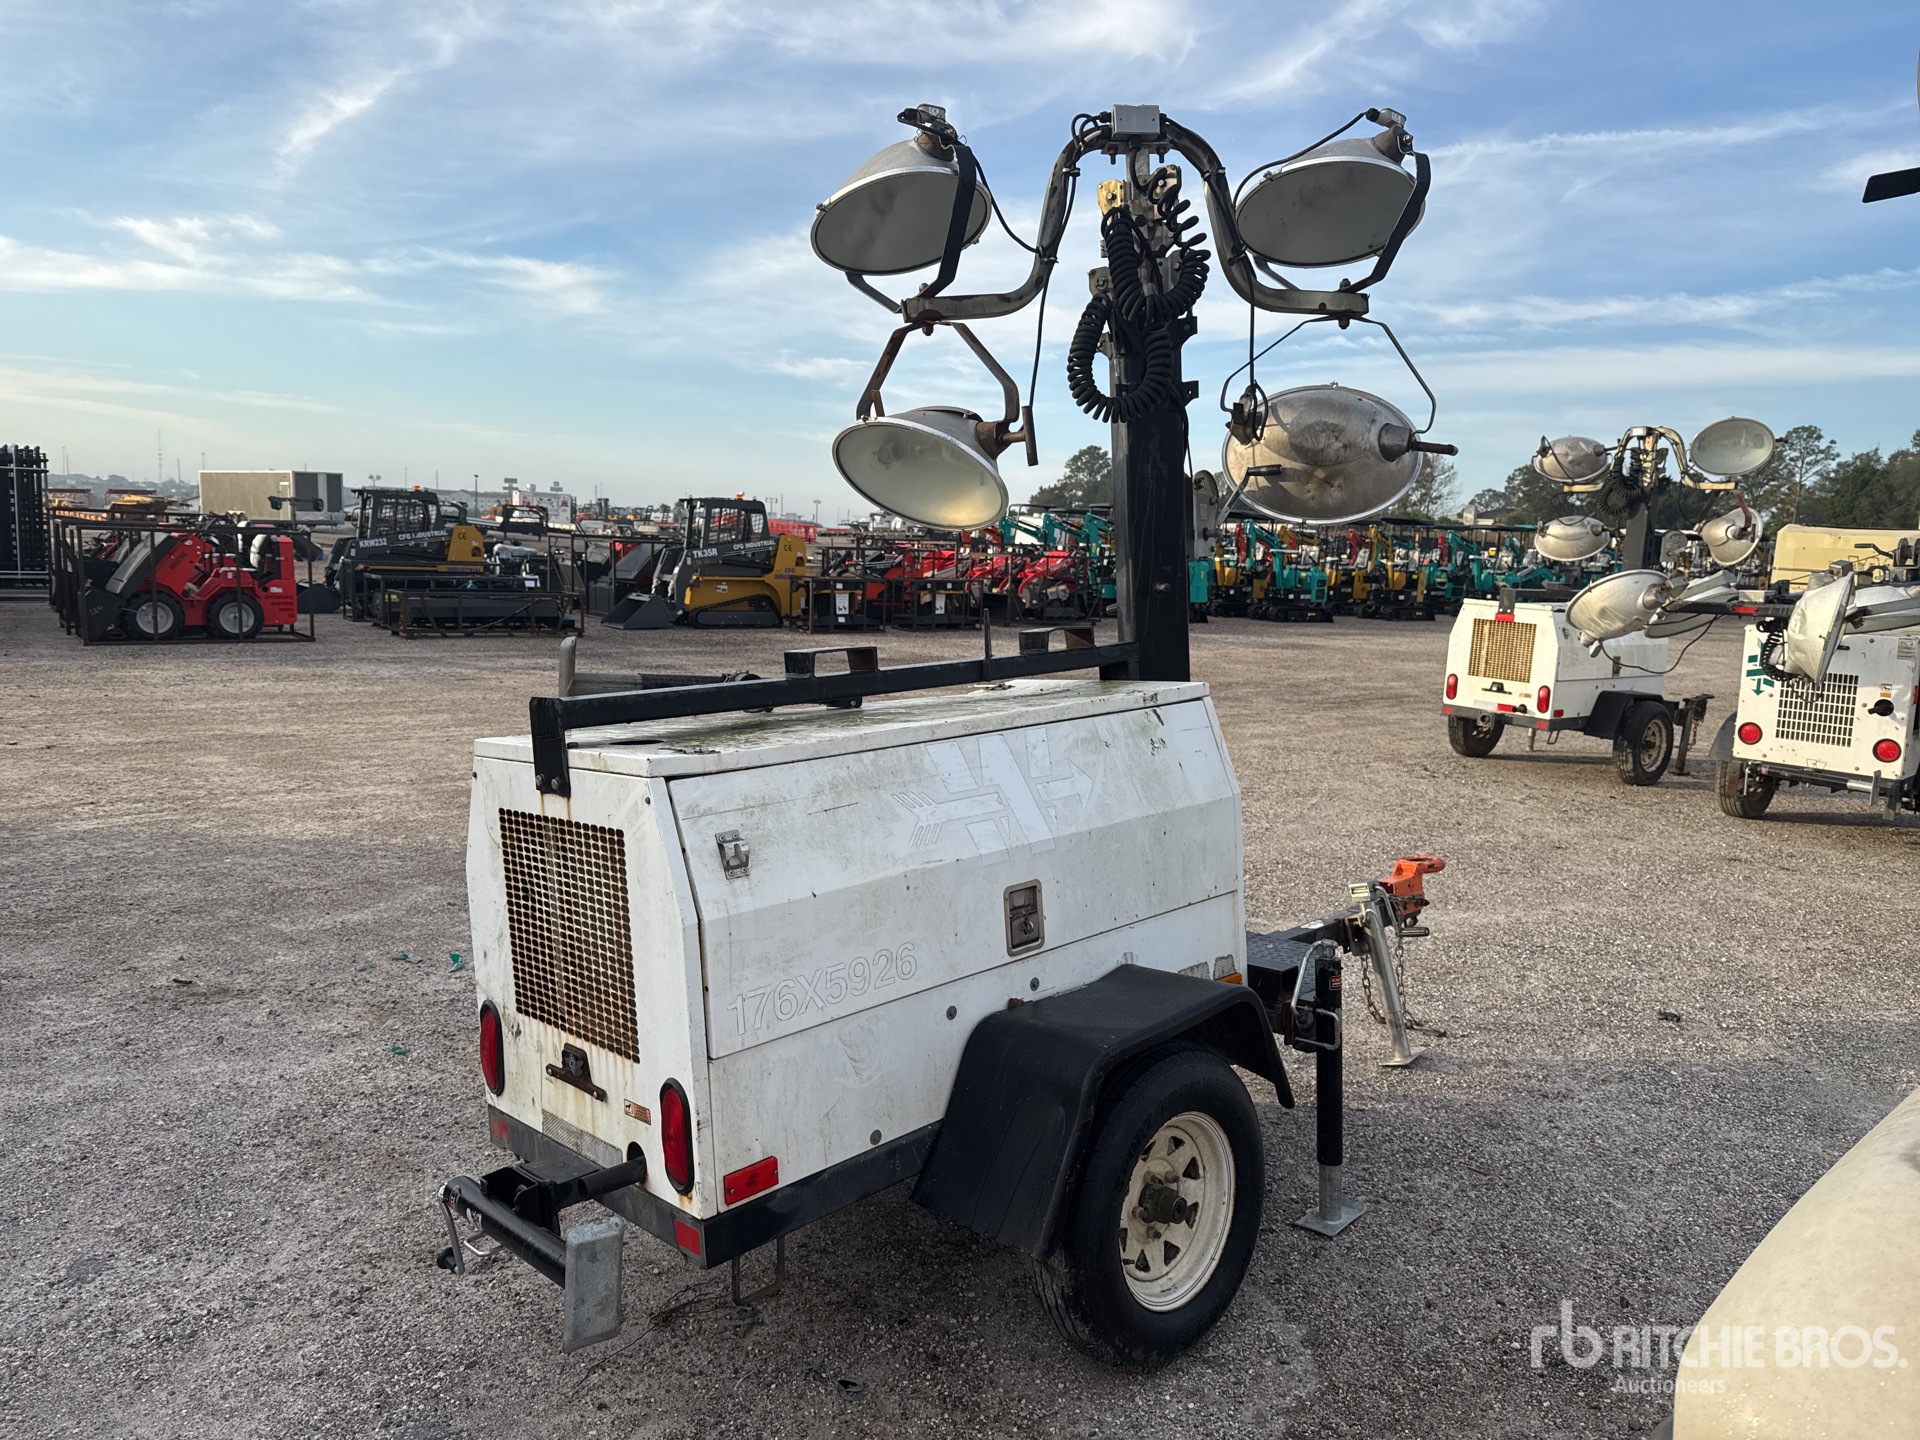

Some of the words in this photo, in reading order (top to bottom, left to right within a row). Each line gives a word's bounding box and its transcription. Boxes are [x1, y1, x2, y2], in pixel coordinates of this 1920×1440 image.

[398, 533, 411, 541] CFG
[359, 537, 388, 549] KRW232
[745, 540, 776, 549] INDUSTRIAL
[783, 544, 793, 552] CE
[692, 548, 718, 559] TK35R
[727, 942, 917, 1036] 176X5926
